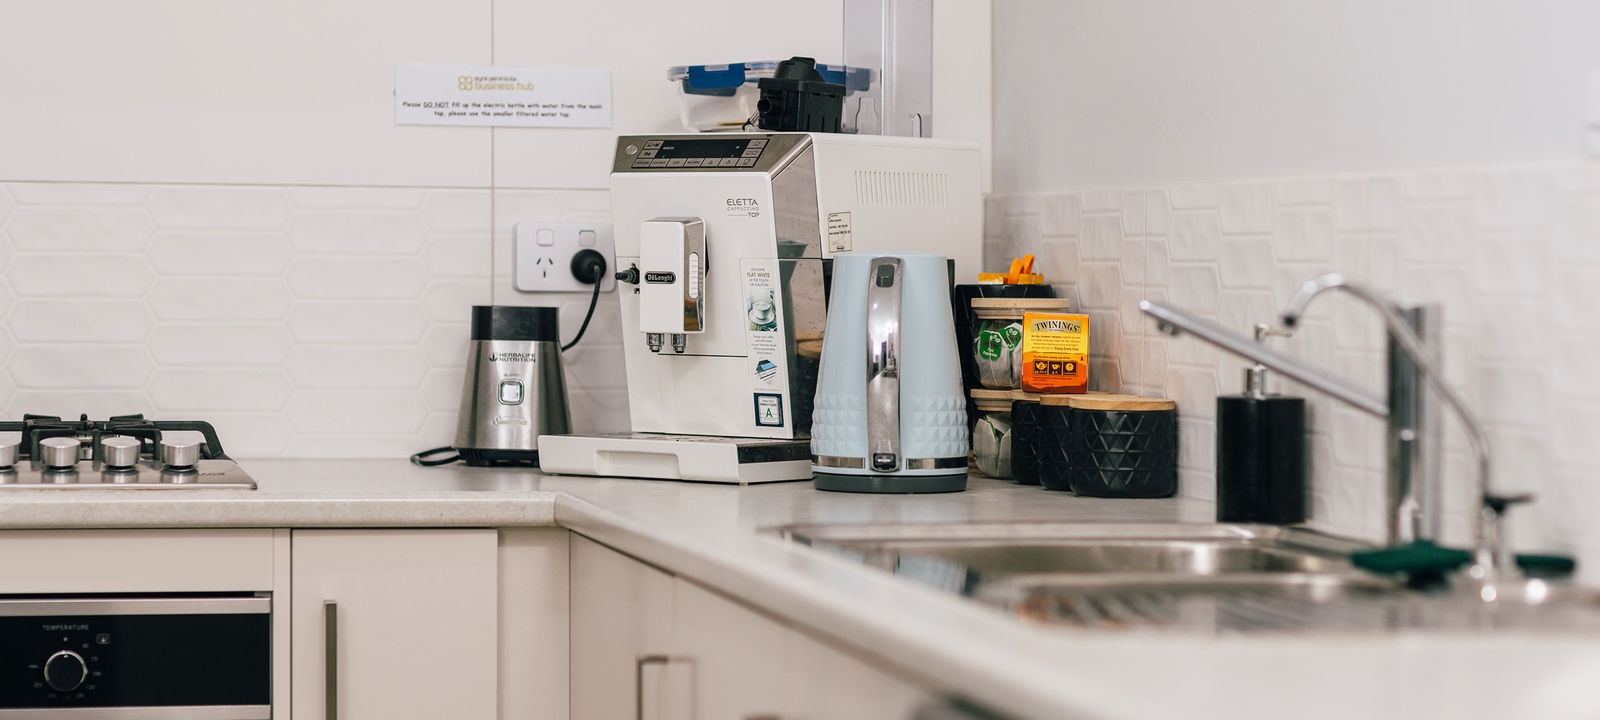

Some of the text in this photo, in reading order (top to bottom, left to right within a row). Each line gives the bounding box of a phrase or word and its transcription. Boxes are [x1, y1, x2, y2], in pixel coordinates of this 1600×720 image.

[475, 82, 535, 90] business hub
[766, 408, 773, 417] A
